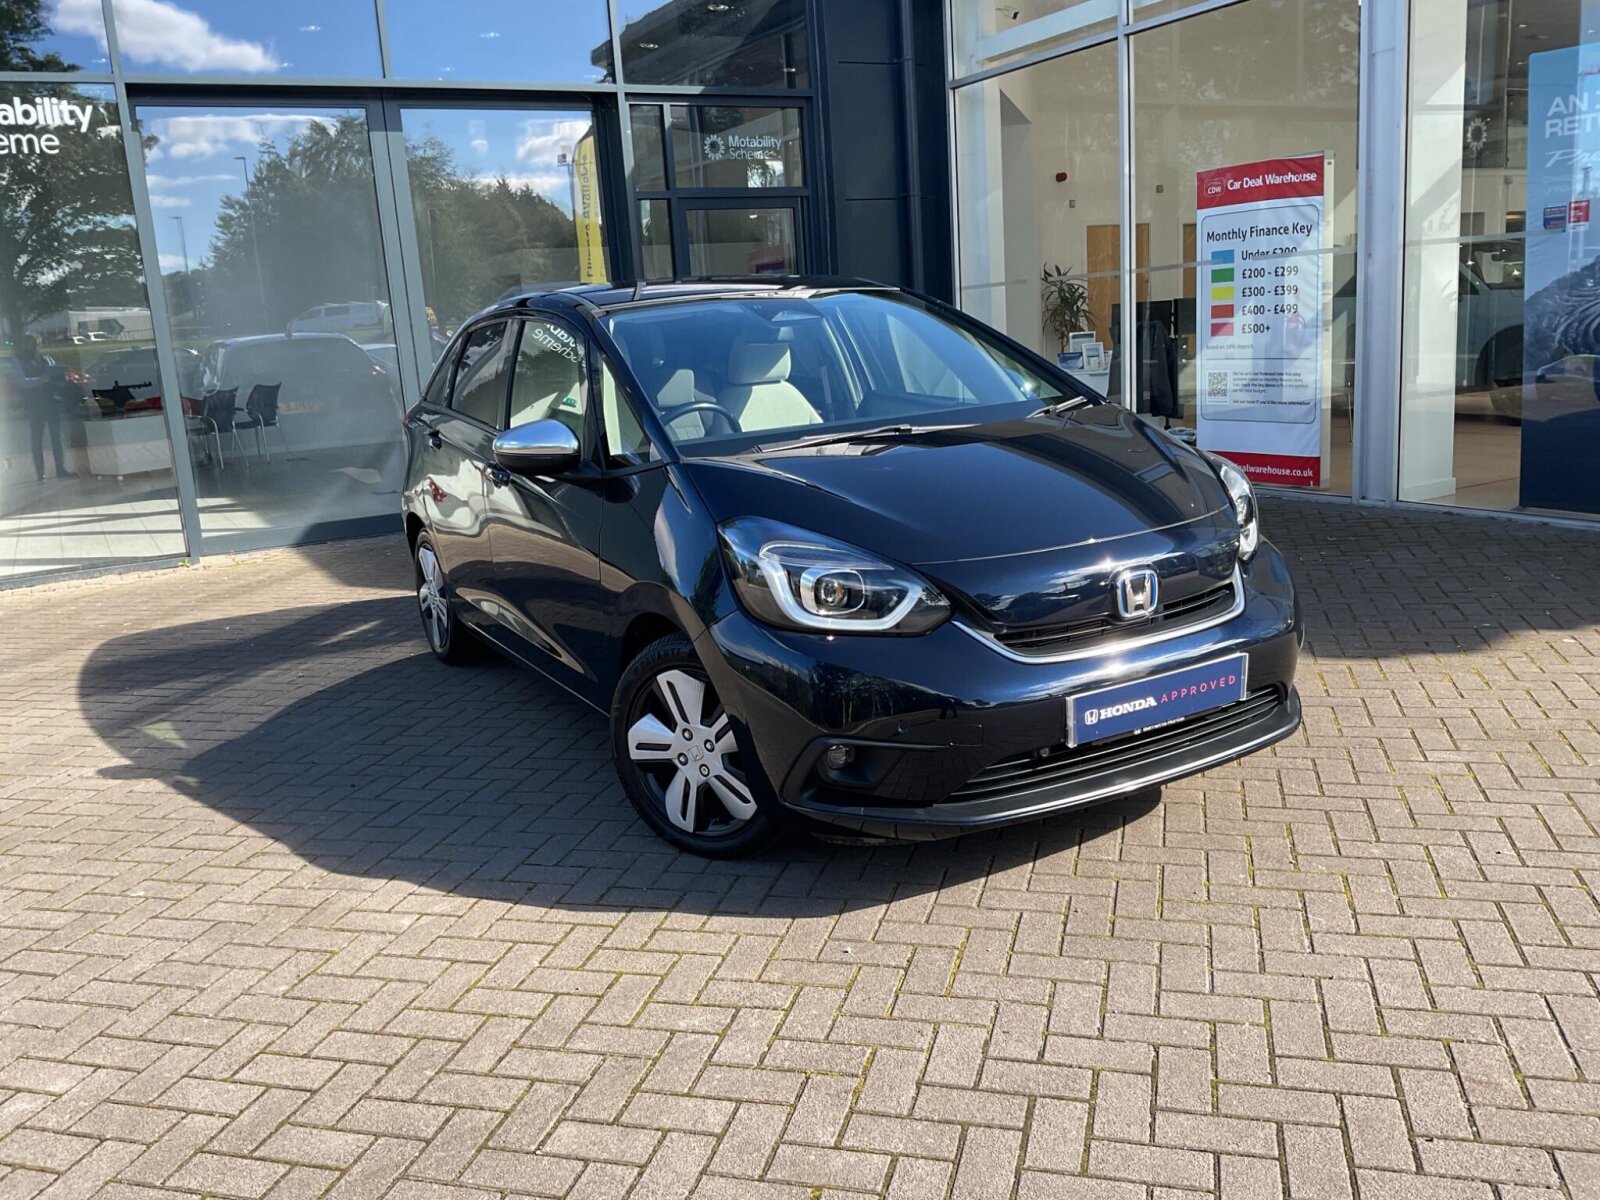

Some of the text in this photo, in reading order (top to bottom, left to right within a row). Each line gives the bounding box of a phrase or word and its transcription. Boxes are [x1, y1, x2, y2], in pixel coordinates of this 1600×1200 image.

[1547, 92, 1588, 117] AN
[1544, 113, 1600, 138] RET
[728, 135, 782, 150] Motability
[729, 148, 769, 160] Scheme
[1227, 172, 1317, 190] Car Deal Warehouse
[1206, 222, 1312, 242] Monthly Finance Key
[1242, 268, 1265, 279] £200
[1274, 266, 1298, 277] £299
[1242, 286, 1265, 297] £300
[1274, 284, 1298, 296] £399
[1242, 304, 1265, 315] £400
[1274, 304, 1298, 314] £499
[1242, 323, 1270, 334] £500+
[1100, 675, 1236, 720] HONDA APPROVED
